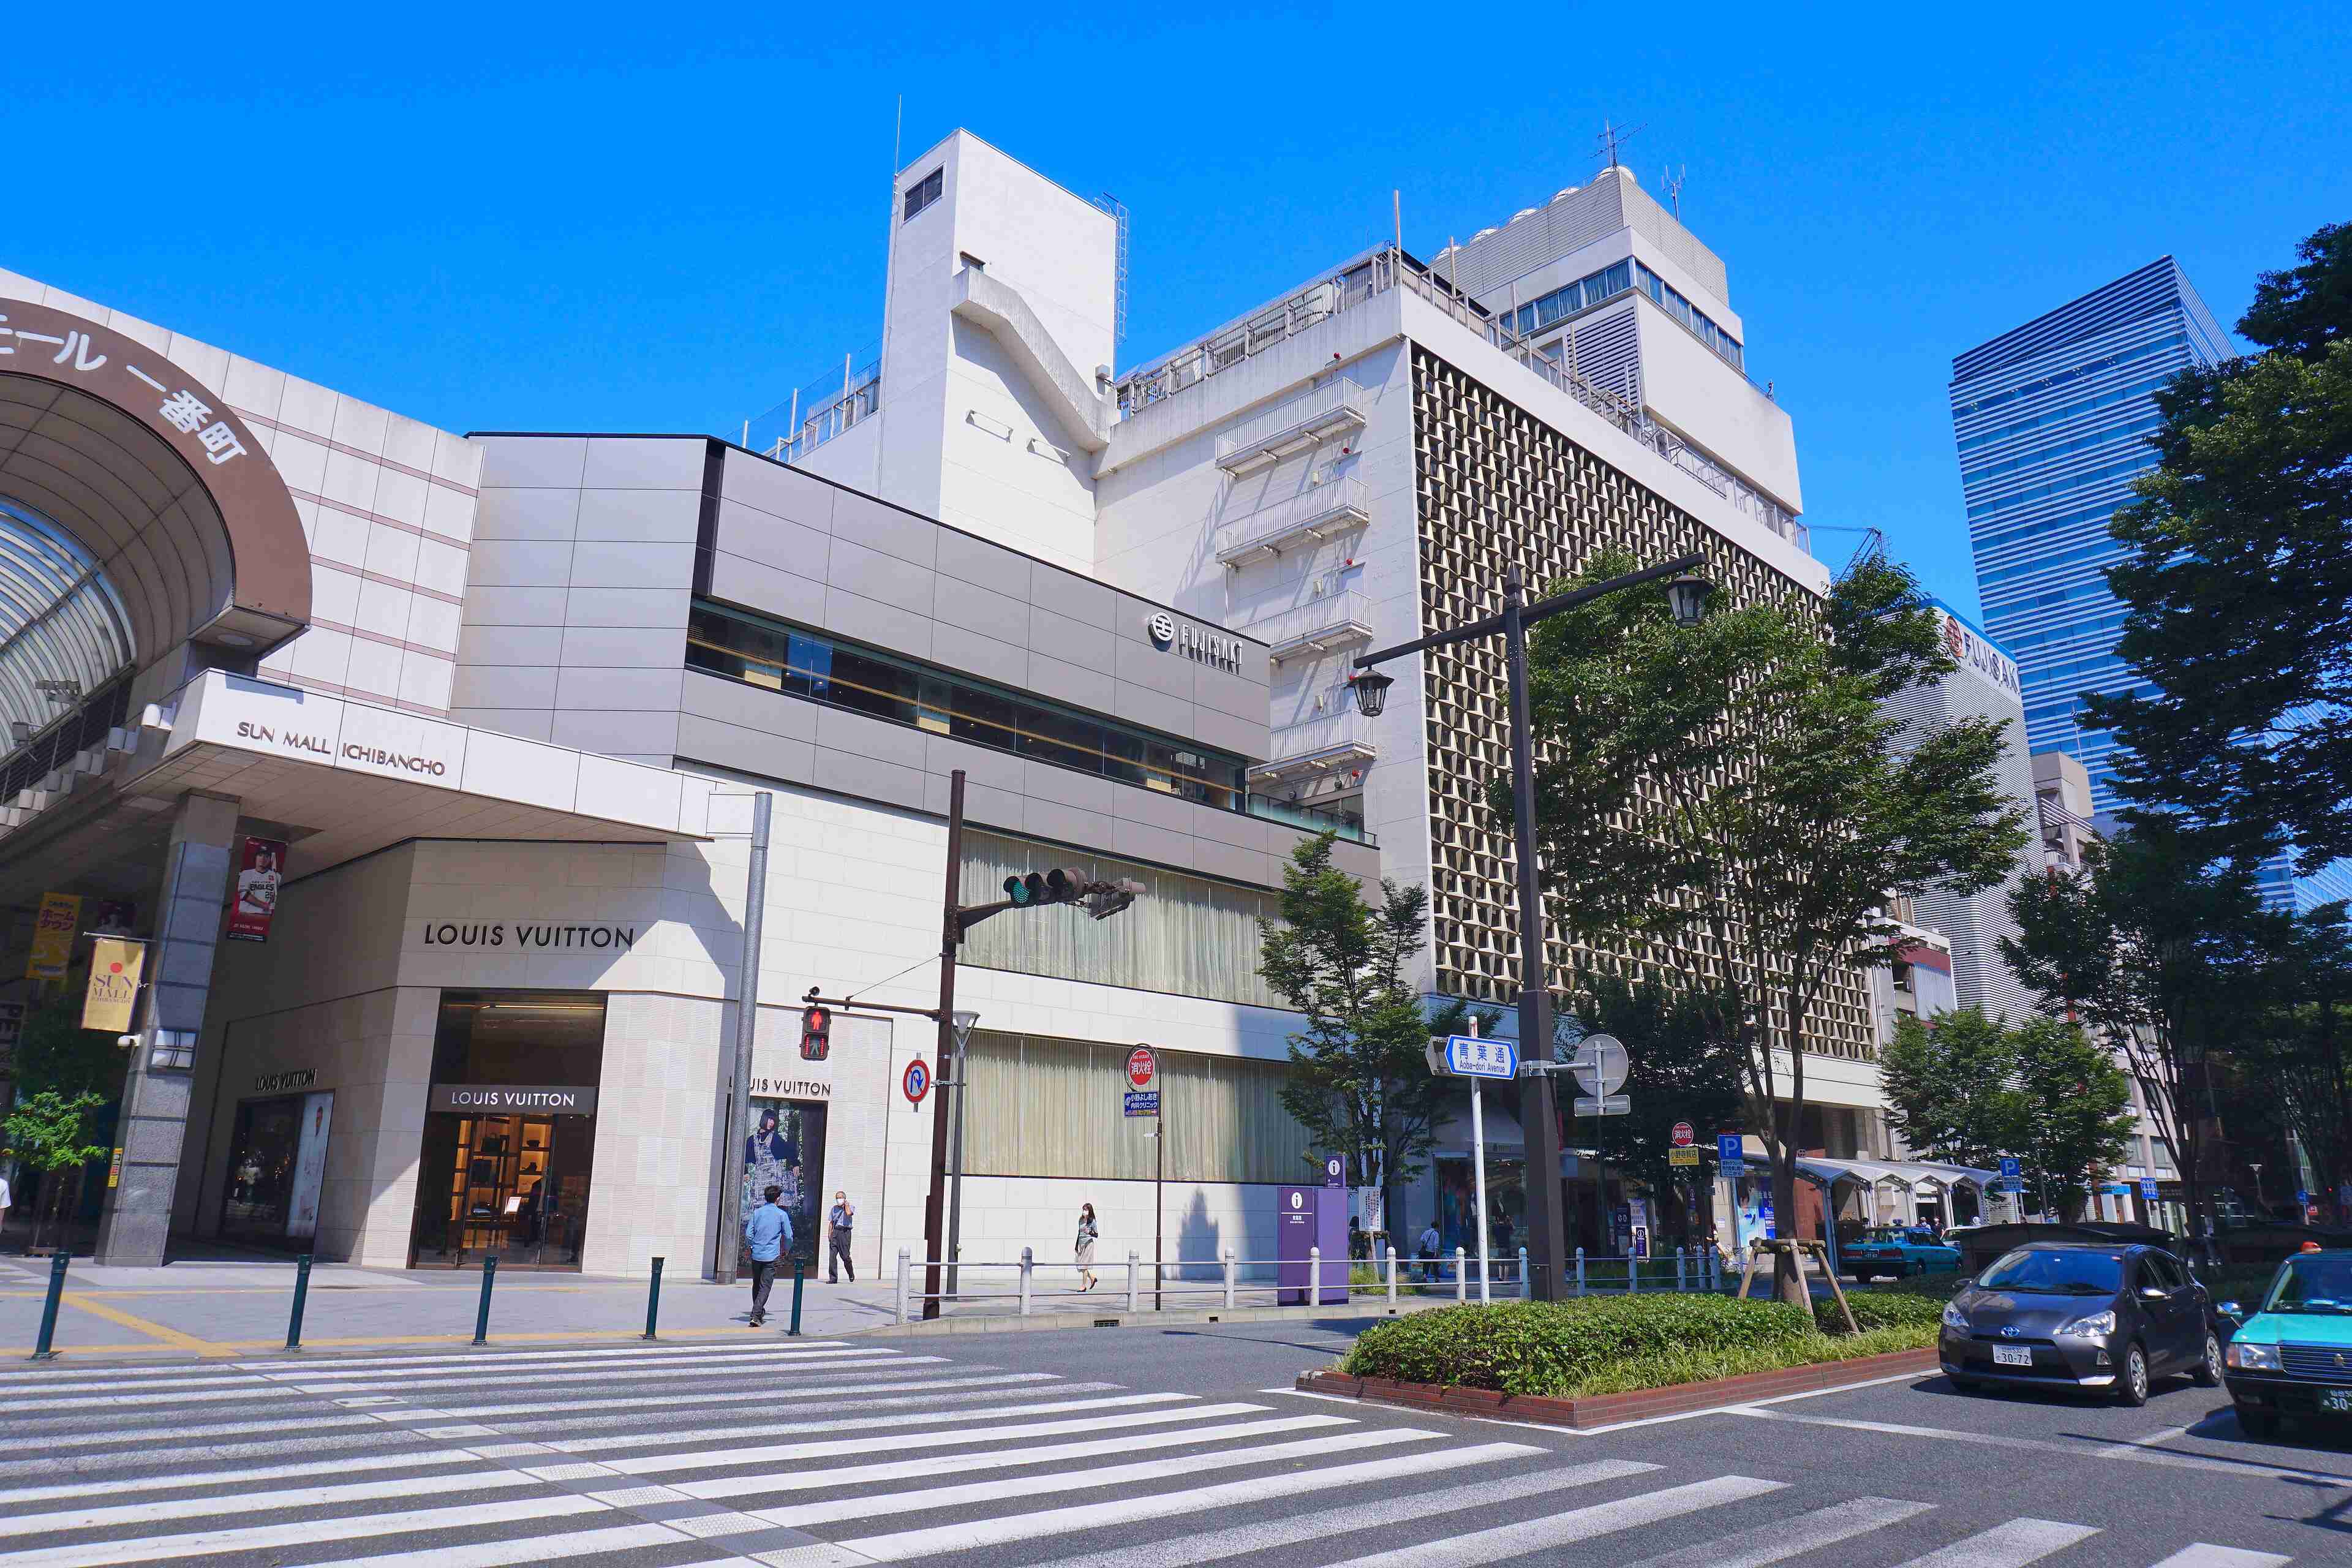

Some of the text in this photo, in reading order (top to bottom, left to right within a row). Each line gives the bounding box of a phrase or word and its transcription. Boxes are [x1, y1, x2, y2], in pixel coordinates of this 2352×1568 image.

[0, 314, 247, 465] ール 一番町
[237, 722, 445, 777] SUN MALL ICHIBANCHO
[424, 924, 633, 949] LOUIS VUITTON
[94, 975, 136, 988] SUN
[92, 987, 132, 999] MALL
[1459, 1042, 1505, 1063] 青葉通
[1131, 1061, 1152, 1075] 消火栓
[1460, 1060, 1506, 1073] Aoba-dori Avenue
[255, 1068, 318, 1092] LOUIS VUITTON
[774, 1080, 831, 1096] VUITTON
[451, 1092, 575, 1107] LOUIS VUITTON
[1675, 1129, 1692, 1139] 消火栓
[1724, 1137, 1738, 1157] P
[2002, 1352, 2029, 1365] 30-72
